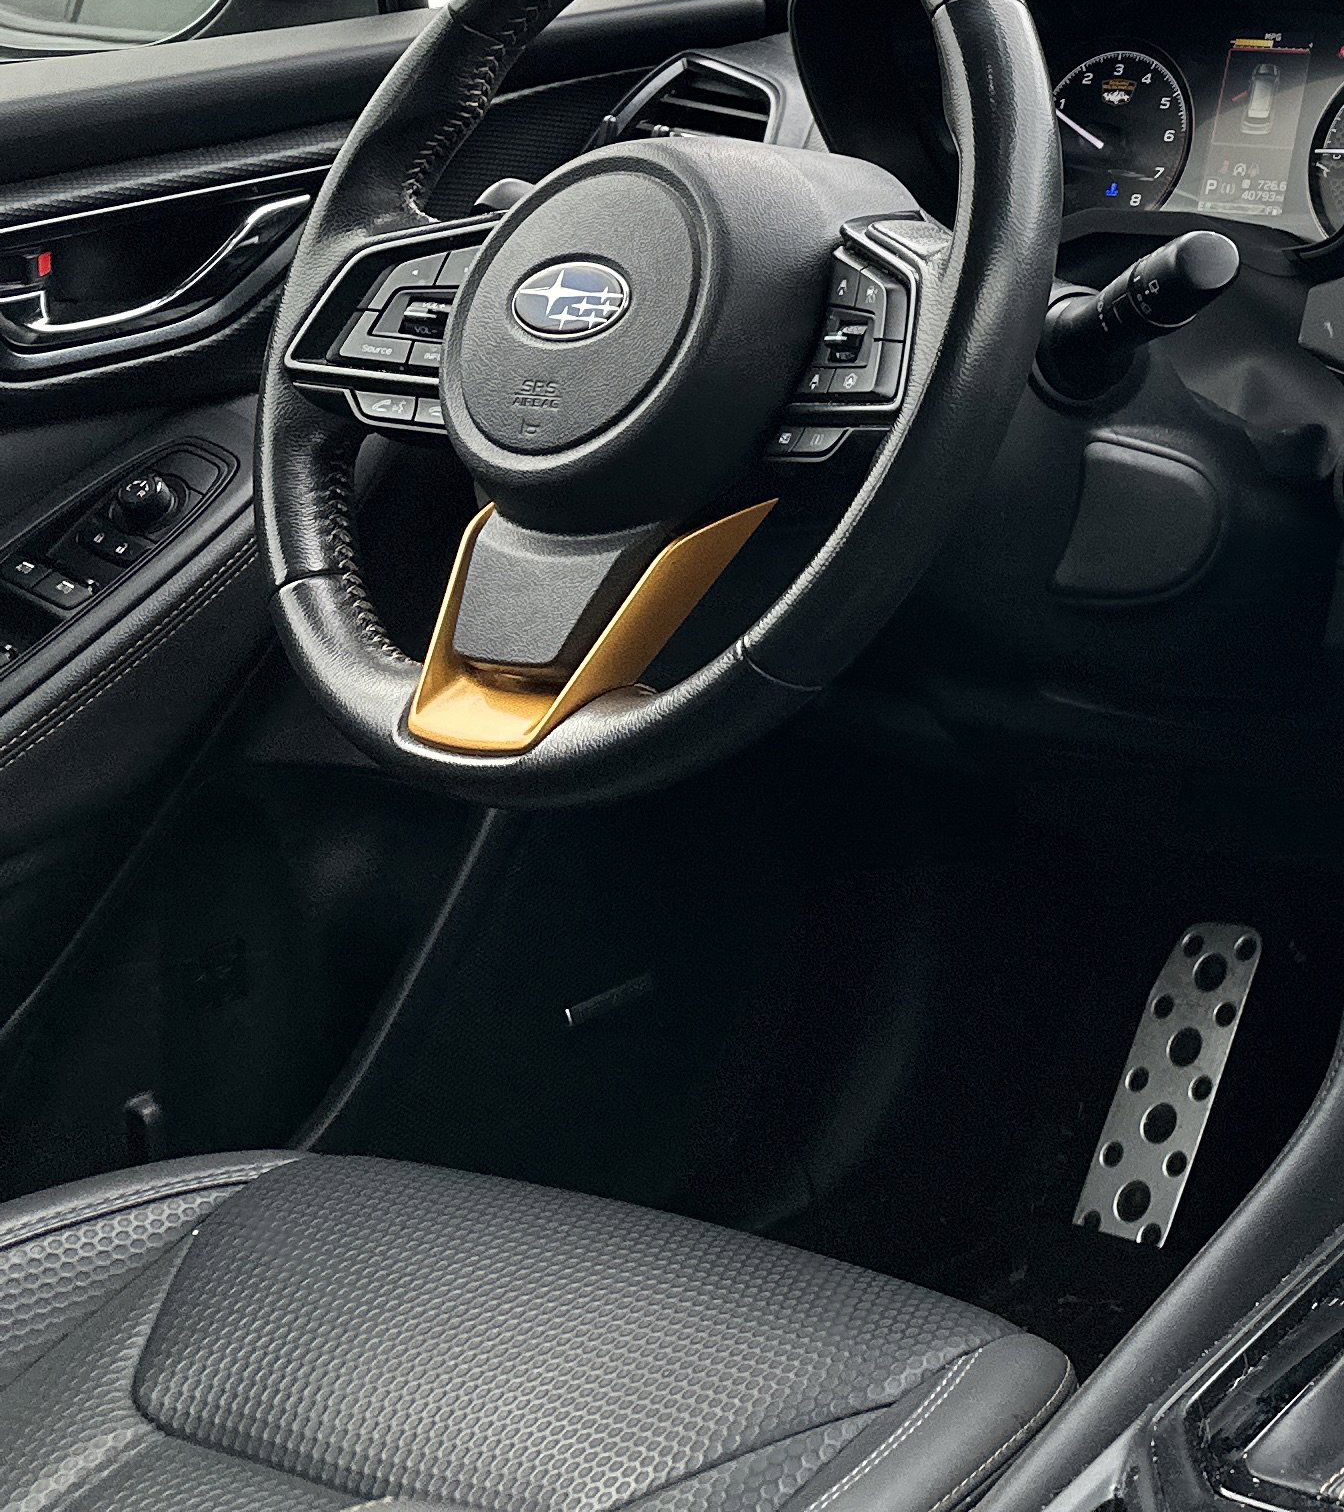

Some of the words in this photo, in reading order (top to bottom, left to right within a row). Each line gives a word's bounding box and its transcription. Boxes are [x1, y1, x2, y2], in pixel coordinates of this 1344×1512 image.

[1113, 64, 1125, 75] 3
[1082, 73, 1094, 84] 2
[1141, 73, 1152, 84] 4
[1160, 97, 1172, 109] 5
[1163, 129, 1176, 142] 6
[1153, 167, 1165, 179] 7
[1205, 179, 1218, 195] P
[1130, 194, 1142, 206] 8
[362, 344, 392, 355] Source
